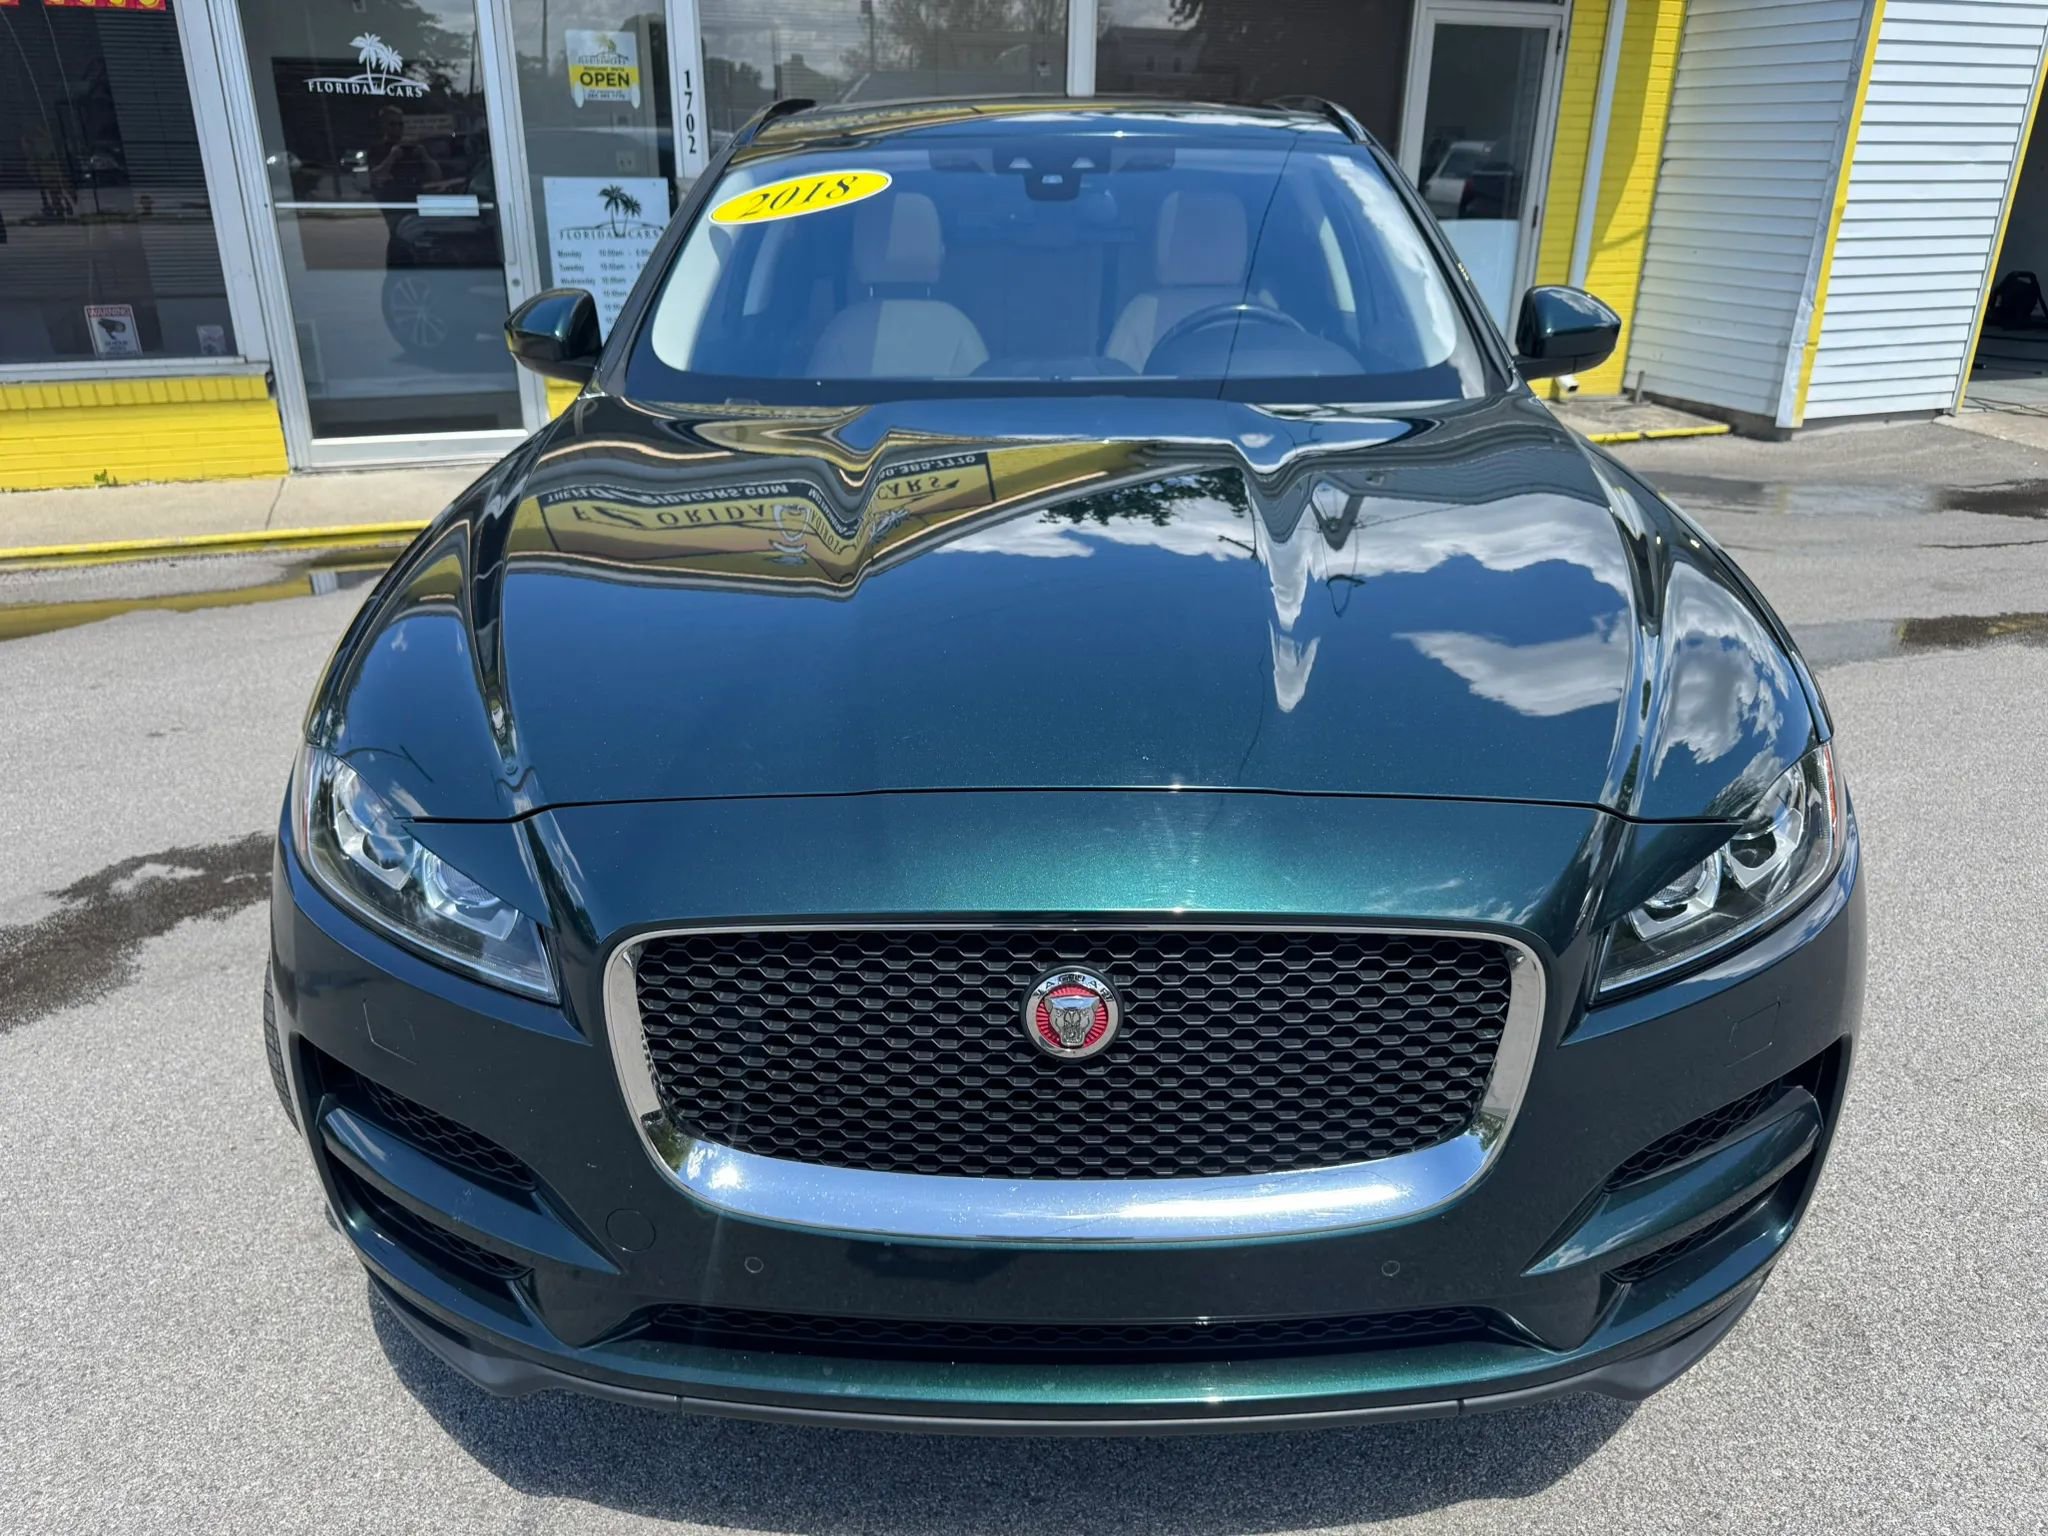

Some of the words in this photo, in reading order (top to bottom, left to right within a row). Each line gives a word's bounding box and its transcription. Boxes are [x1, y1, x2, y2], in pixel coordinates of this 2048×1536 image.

[579, 71, 631, 88] OPEN
[308, 81, 371, 95] FLORIDA
[386, 84, 423, 98] CARS
[683, 68, 697, 155] 1702
[736, 175, 859, 220] 2018
[560, 230, 613, 241] FLORIDA
[627, 230, 660, 241] CARS
[557, 249, 582, 259] Monday
[559, 263, 585, 272] Tuesday
[561, 278, 596, 288] Wednesday
[88, 306, 131, 317] WARNING
